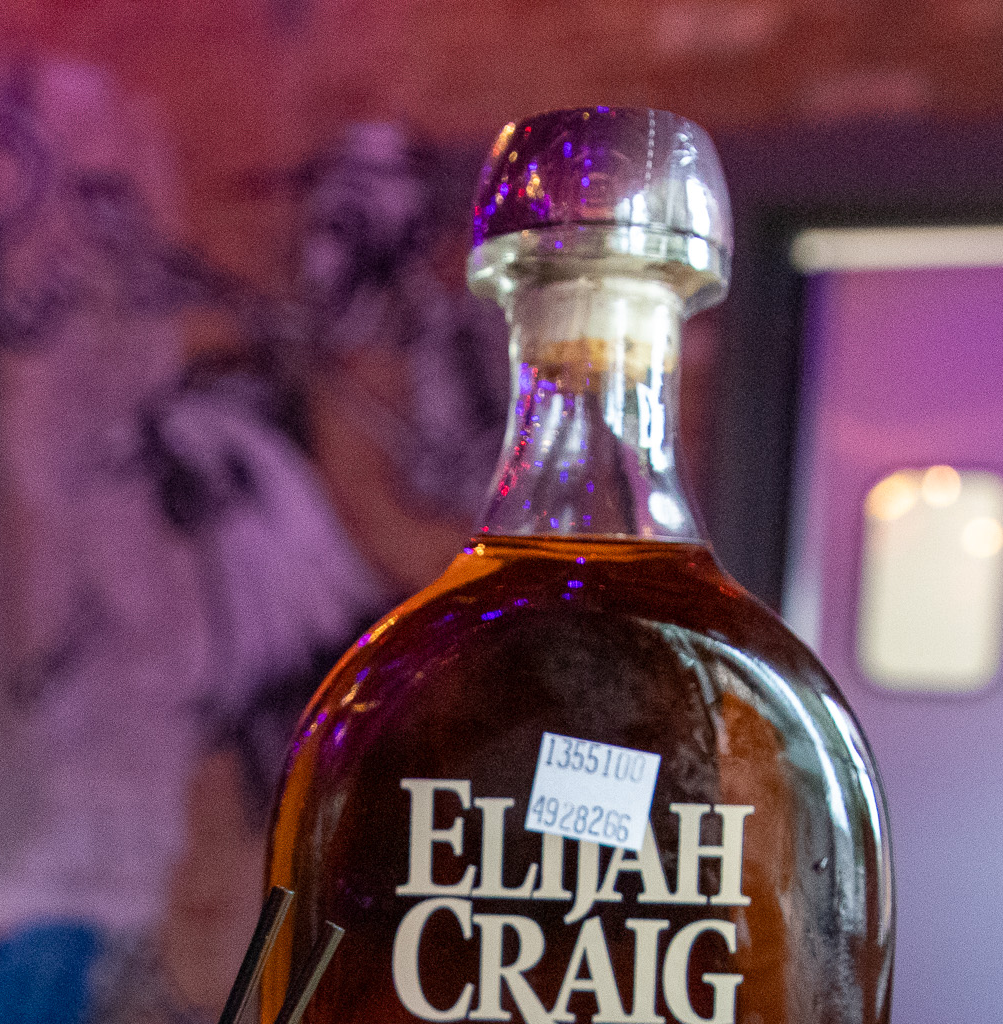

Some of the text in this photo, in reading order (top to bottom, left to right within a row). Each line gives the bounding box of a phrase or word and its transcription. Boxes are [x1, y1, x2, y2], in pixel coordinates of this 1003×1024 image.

[545, 737, 647, 783] 1355100
[532, 794, 632, 843] 4928266
[396, 778, 755, 924] ELIJAH
